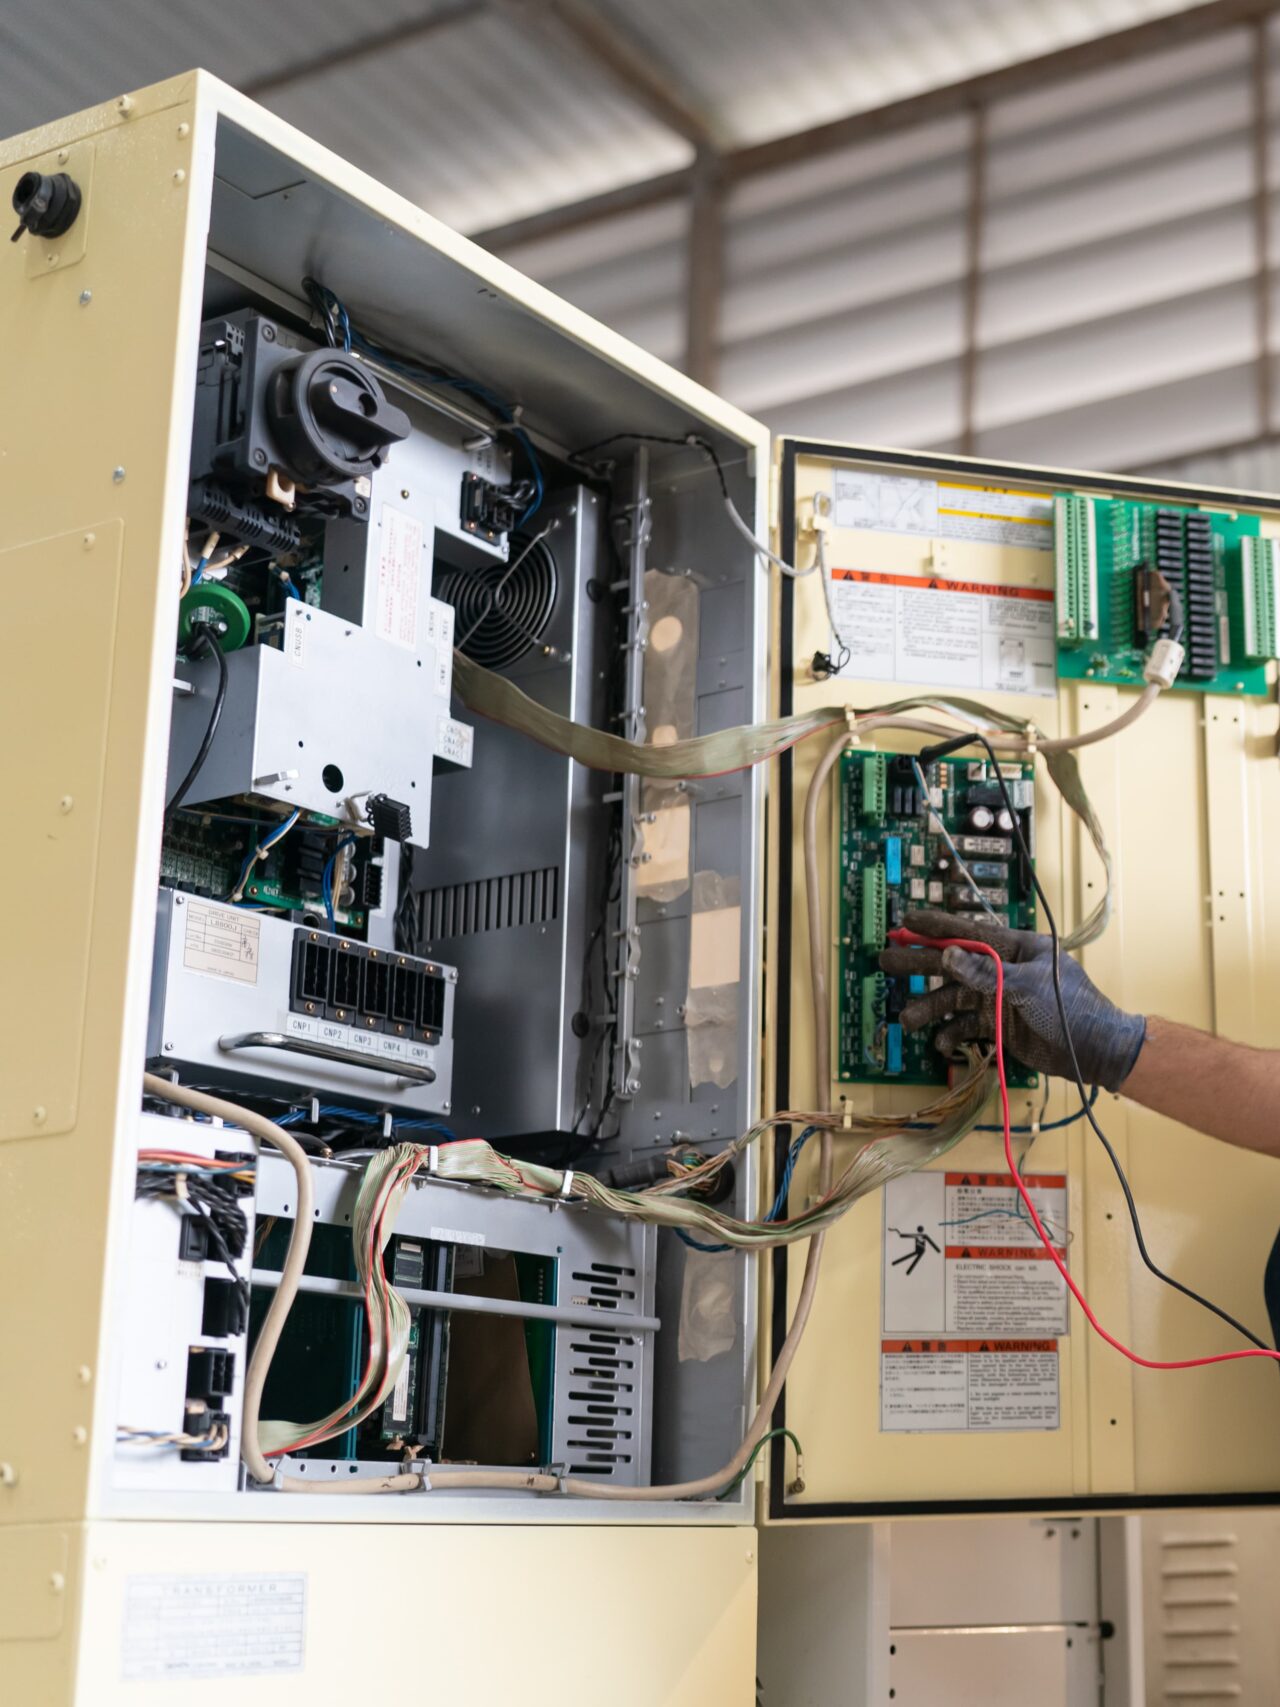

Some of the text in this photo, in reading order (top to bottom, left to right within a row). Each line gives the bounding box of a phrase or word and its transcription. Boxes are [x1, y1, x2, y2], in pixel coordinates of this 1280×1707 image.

[946, 580, 1020, 597] WARNING
[293, 1020, 311, 1032] CNP1
[324, 1027, 342, 1039] CNP2
[354, 1034, 372, 1046] CNP3
[383, 1041, 401, 1053] CNP4
[412, 1047, 429, 1059] CNP5
[978, 1247, 1036, 1258] WARNING
[993, 1340, 1051, 1351] WARNING
